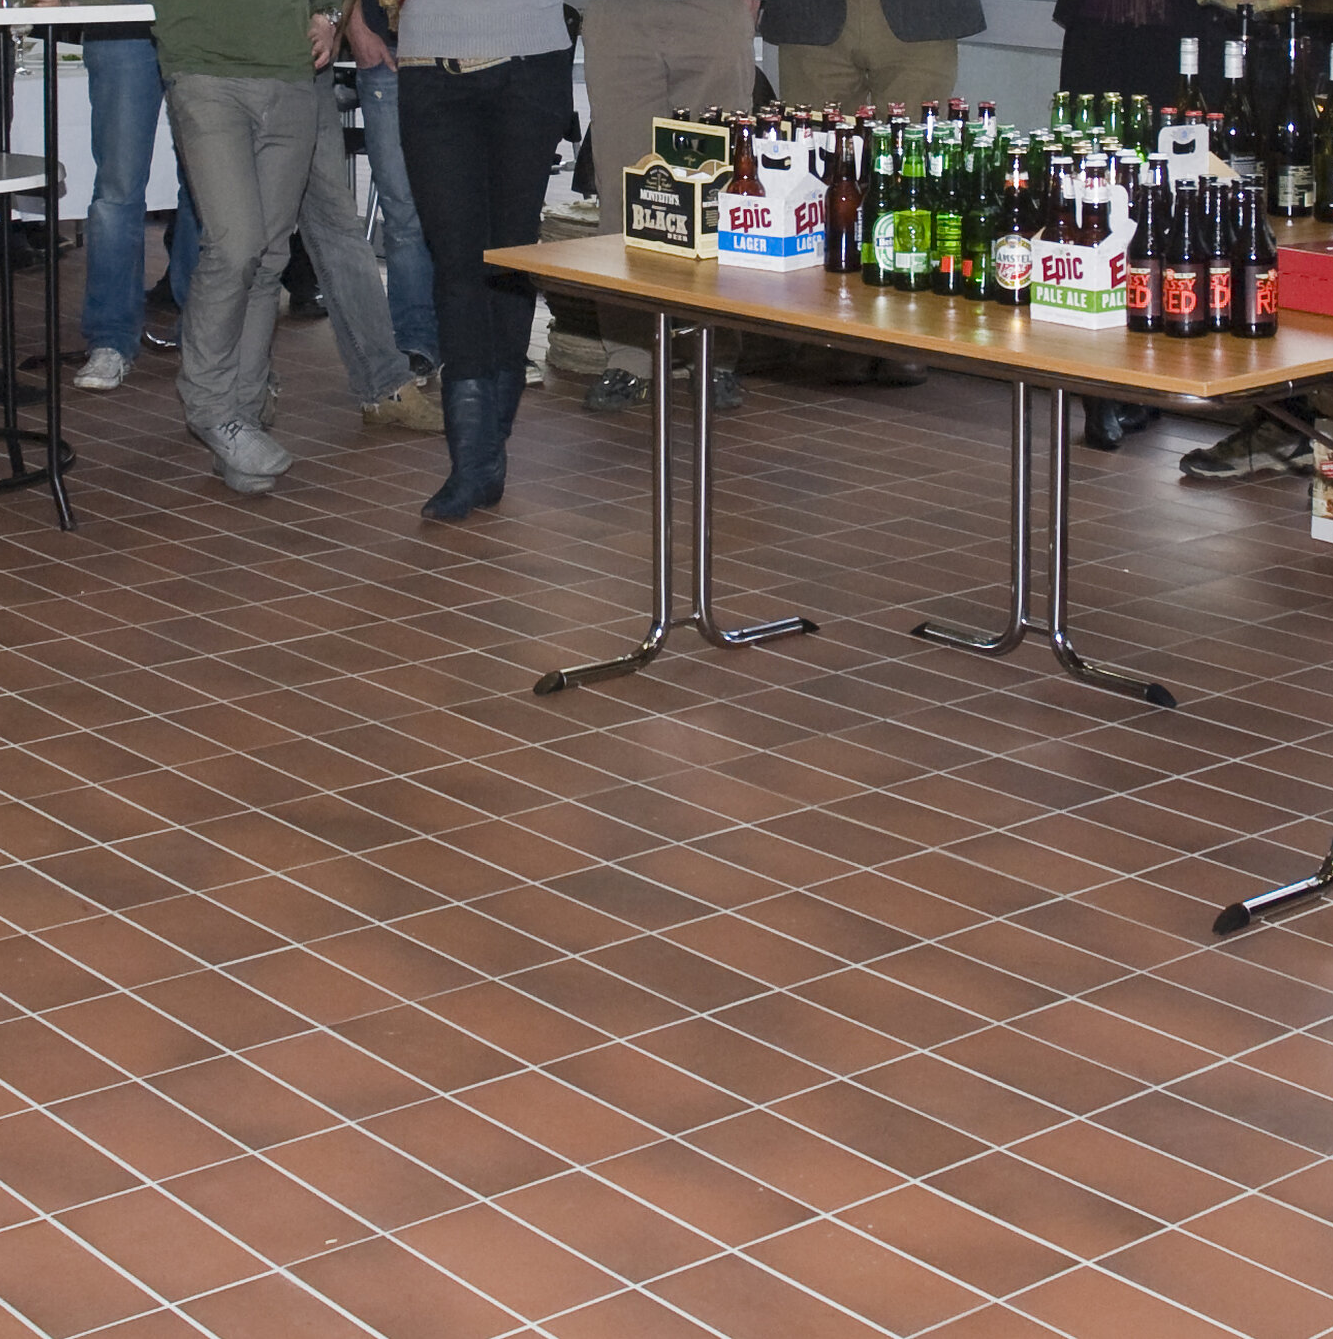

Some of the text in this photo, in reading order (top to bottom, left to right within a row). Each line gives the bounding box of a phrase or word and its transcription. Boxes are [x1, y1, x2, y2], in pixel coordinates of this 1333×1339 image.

[631, 203, 688, 235] BLACK
[729, 203, 772, 233] Epic
[794, 193, 826, 235] Epi
[733, 235, 767, 253] LAGER
[996, 252, 1032, 263] AMSTEL
[1041, 252, 1083, 285] Epic
[1127, 284, 1151, 308] ED
[1165, 278, 1196, 290] SSY
[1036, 285, 1087, 308] PALE ALE
[1255, 290, 1278, 314] RE
